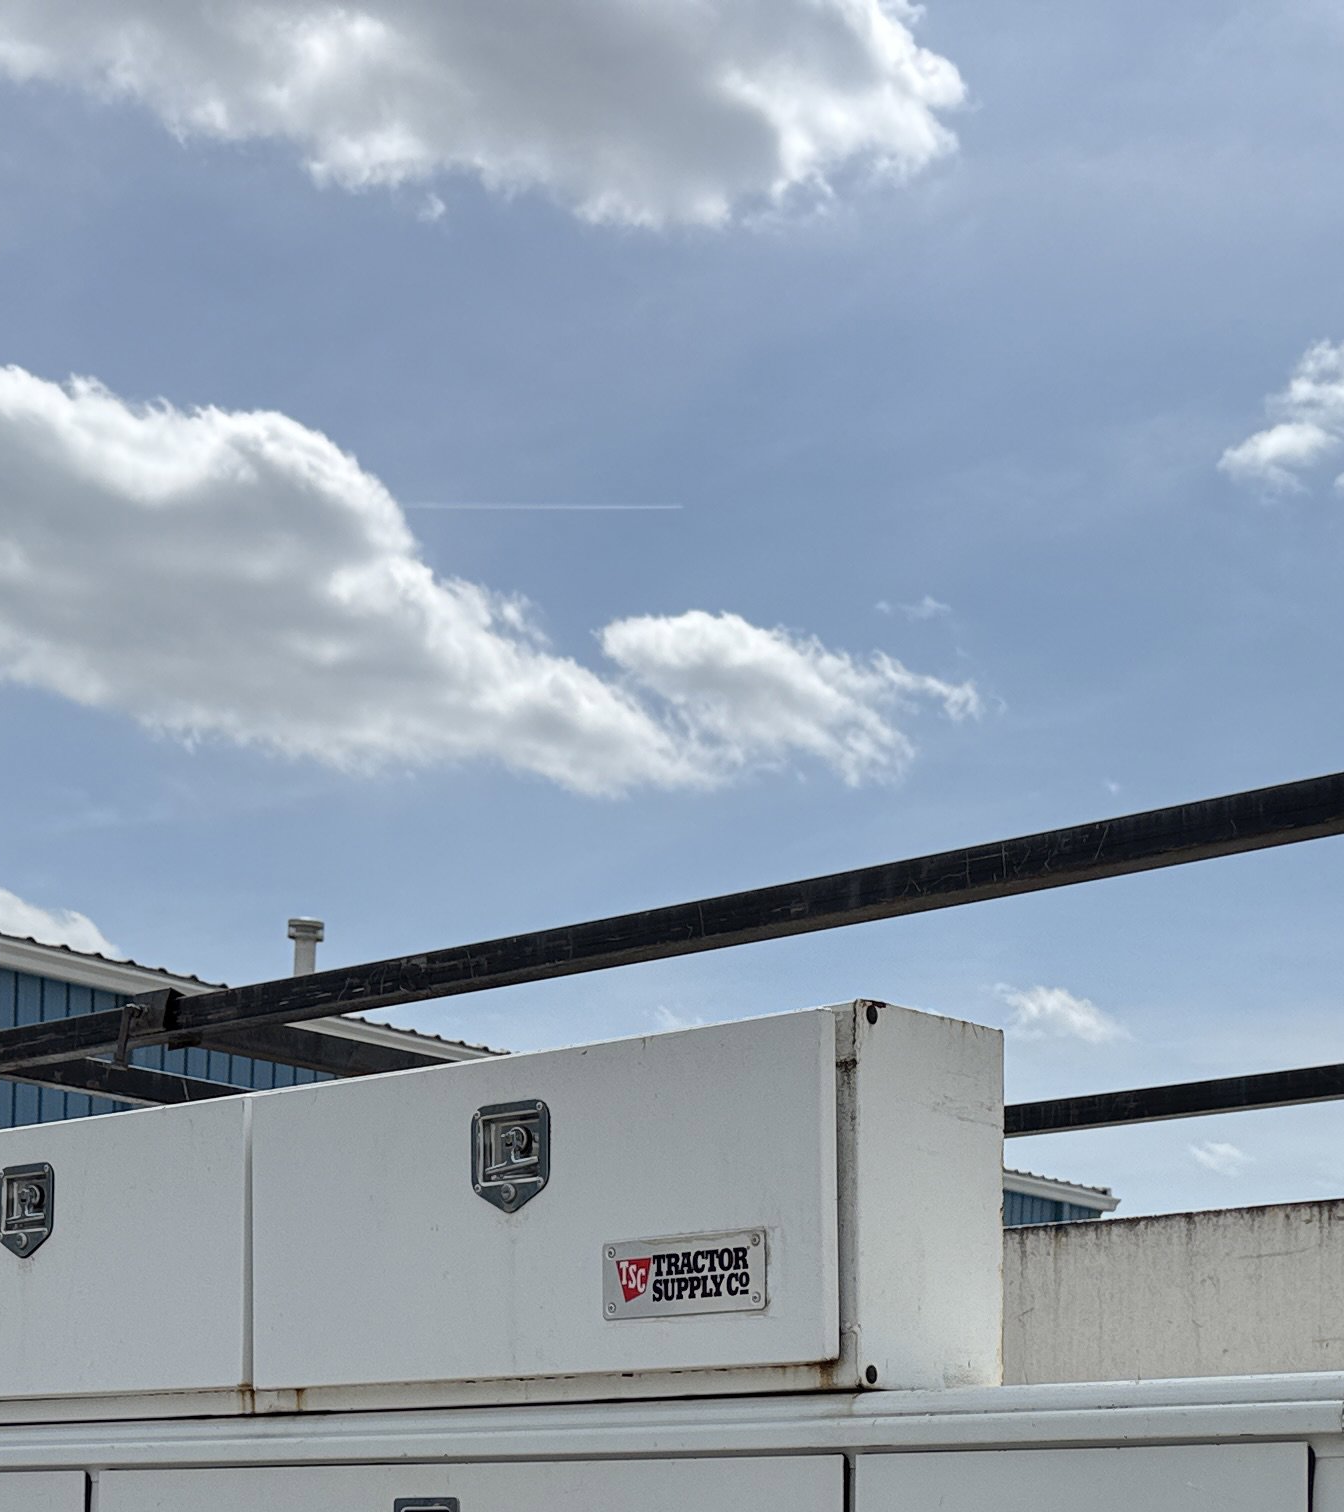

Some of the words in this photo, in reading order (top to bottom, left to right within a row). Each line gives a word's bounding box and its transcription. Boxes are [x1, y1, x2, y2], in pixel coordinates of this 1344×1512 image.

[619, 1260, 646, 1293] TSC
[652, 1246, 749, 1277] TRACTOR
[652, 1273, 726, 1302] SUPPLY
